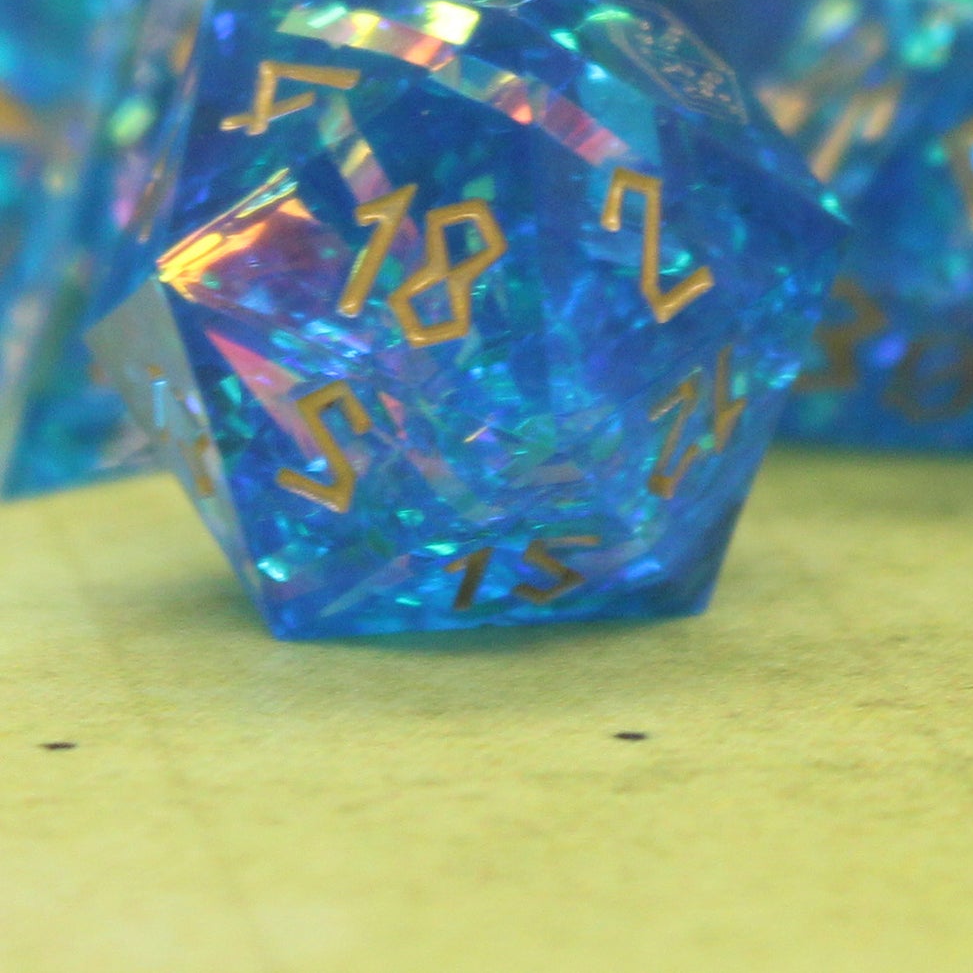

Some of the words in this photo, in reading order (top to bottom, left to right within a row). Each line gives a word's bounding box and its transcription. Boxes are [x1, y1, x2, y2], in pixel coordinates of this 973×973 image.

[338, 182, 508, 349] 18
[602, 168, 714, 324] 2
[443, 534, 603, 611] 15
